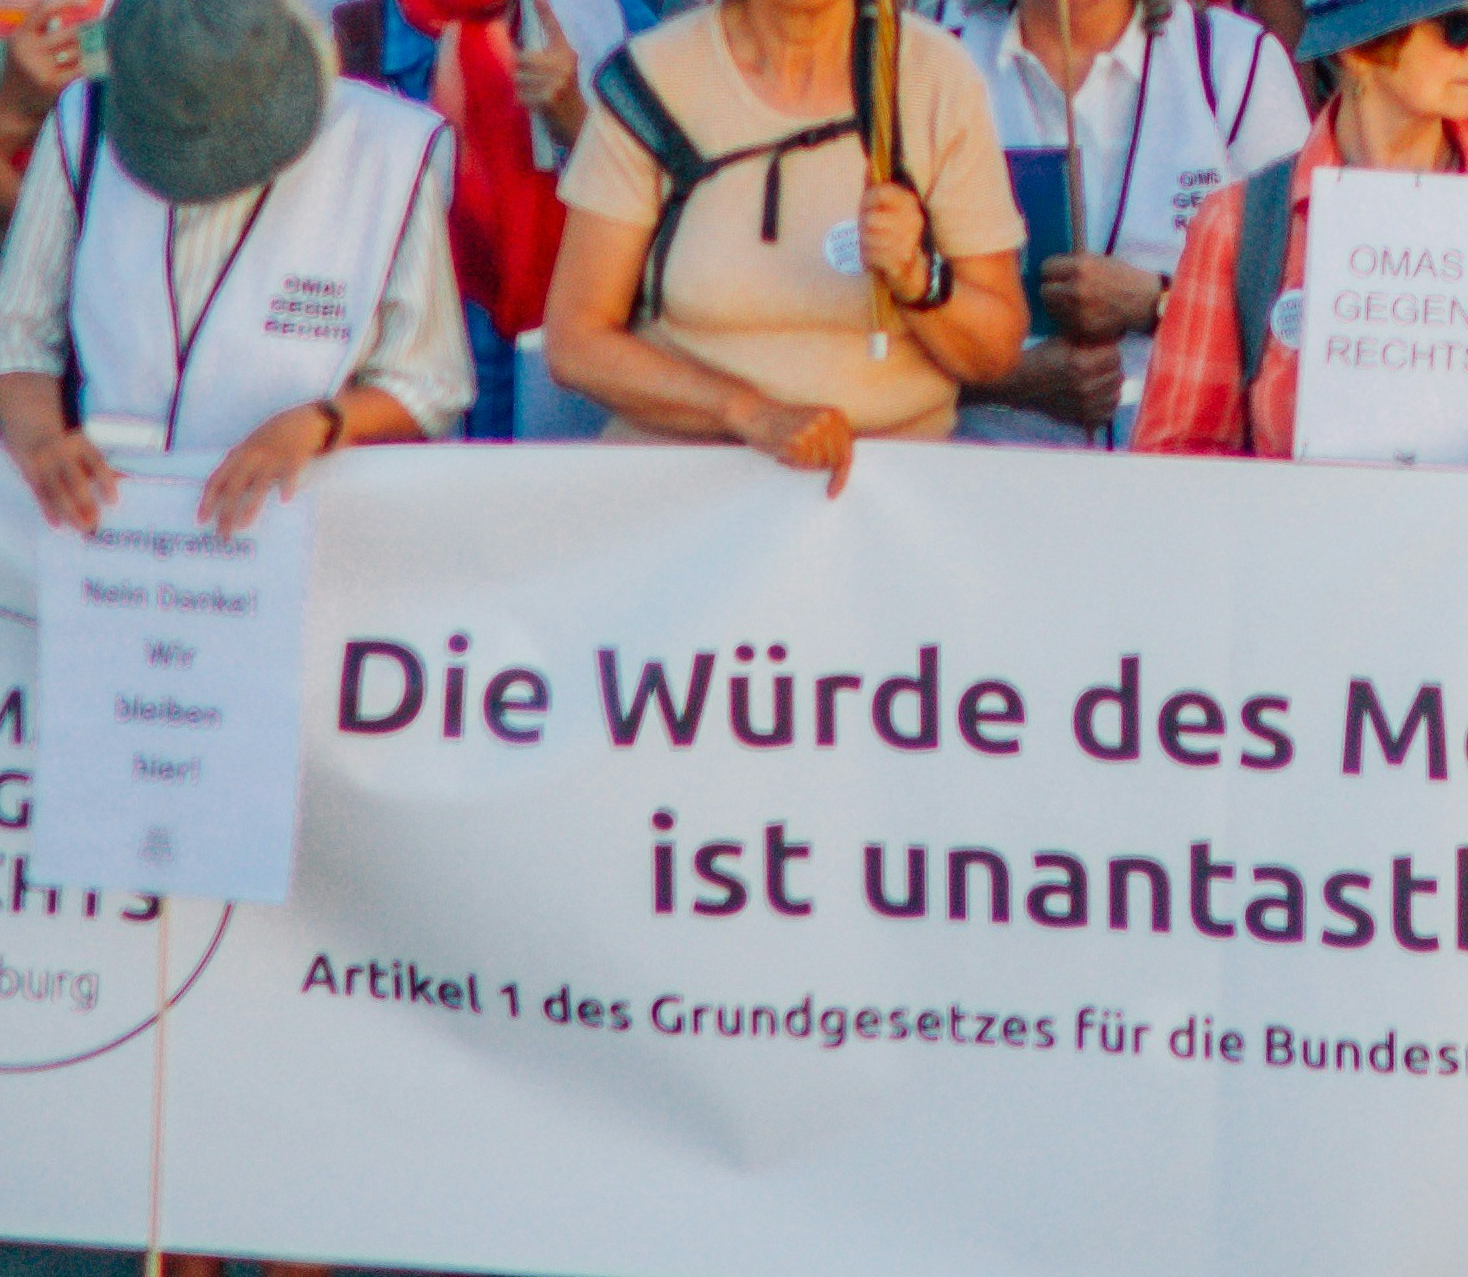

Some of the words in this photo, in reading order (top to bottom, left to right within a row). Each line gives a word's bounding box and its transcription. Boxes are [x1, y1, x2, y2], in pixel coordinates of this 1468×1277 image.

[1348, 244, 1465, 282] OMAS
[143, 641, 196, 670] Wir
[336, 632, 554, 746] Die
[595, 641, 1027, 755] Würde
[1072, 652, 1295, 772] des
[650, 810, 814, 917] ist
[302, 953, 484, 1017] Artikel
[500, 982, 522, 1018] 1
[542, 984, 633, 1033] des
[650, 994, 1056, 1052] Grundgesetzes
[1075, 1005, 1149, 1057] für
[1168, 1012, 1245, 1064] die
